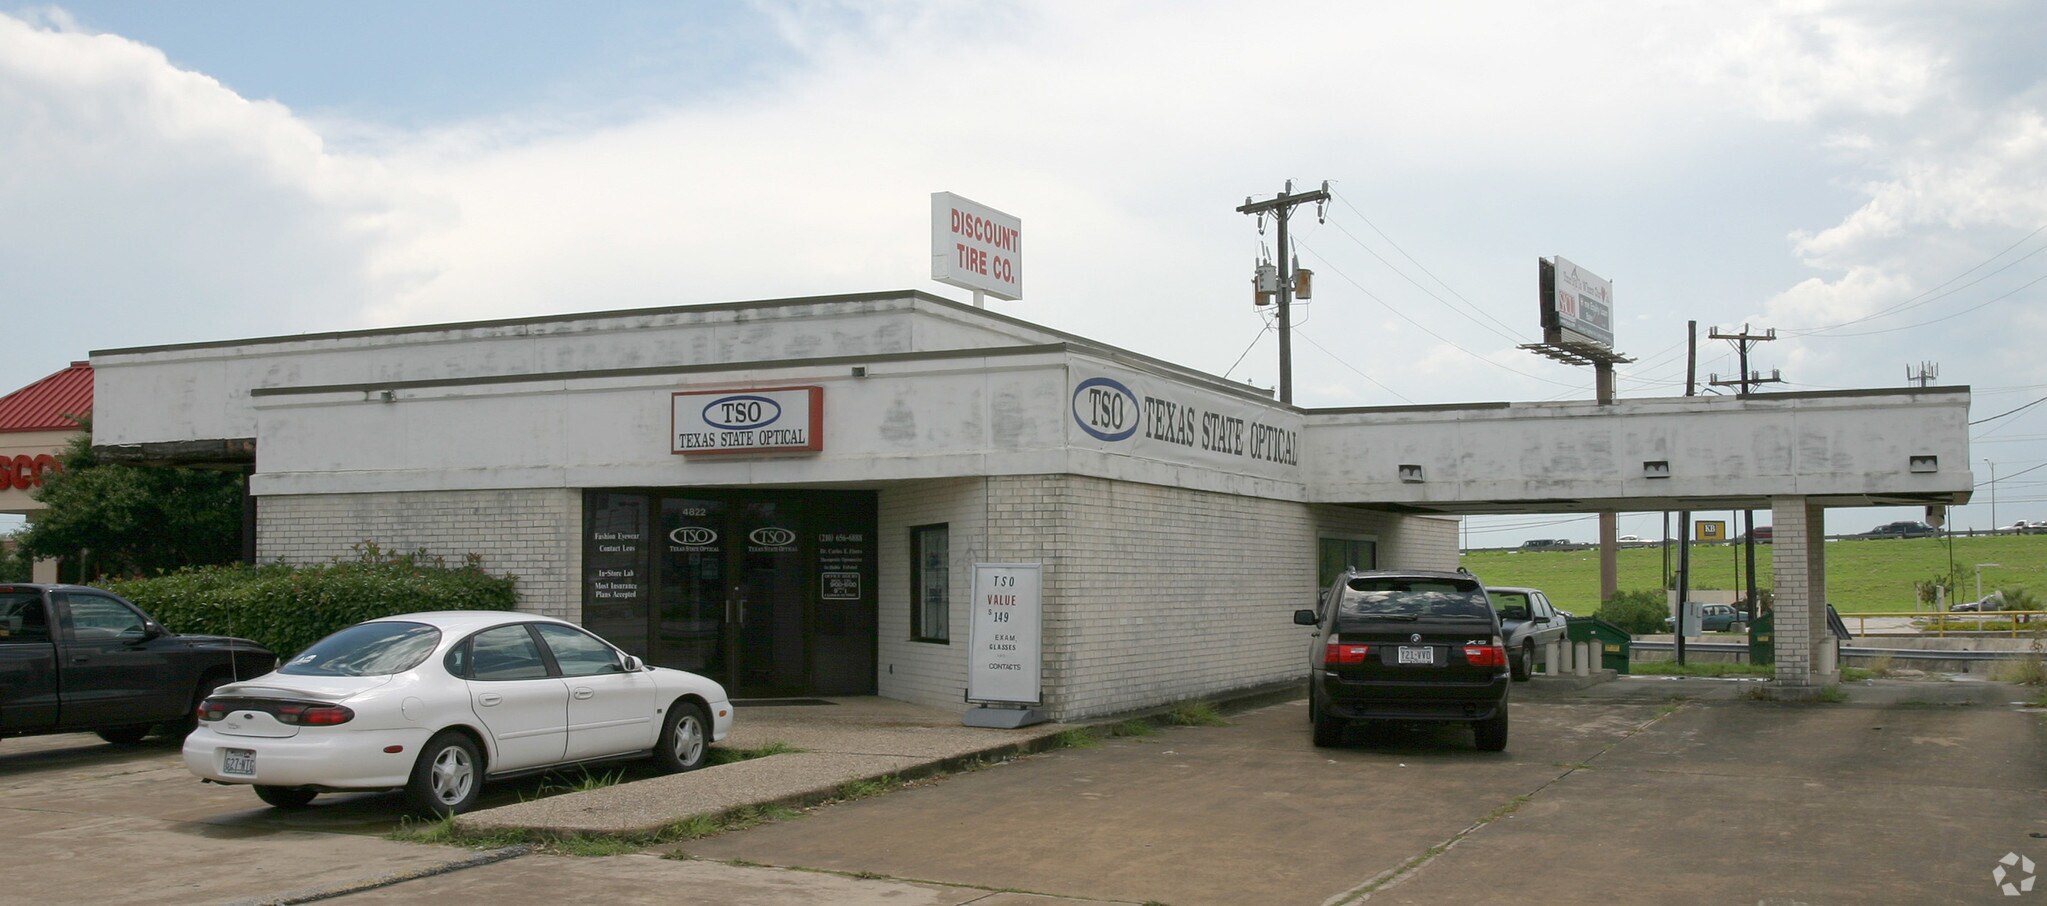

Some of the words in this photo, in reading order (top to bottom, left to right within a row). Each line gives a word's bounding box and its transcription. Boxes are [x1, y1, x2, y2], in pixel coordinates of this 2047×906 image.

[951, 207, 1019, 253] DISCOUNT
[957, 243, 987, 276] TIRE
[993, 255, 1015, 284] CO.
[721, 401, 762, 423] TSO
[1088, 388, 1124, 430] TSO
[1144, 396, 1195, 447] TEXAS
[1201, 411, 1244, 456] STATE
[1249, 422, 1298, 466] OPTICAL
[679, 432, 715, 448] TEXAS
[720, 430, 754, 447] STATE
[759, 428, 805, 446] OPTICAL
[682, 507, 706, 517] 4822
[1705, 524, 1716, 533] KB
[594, 532, 616, 540] Fashion
[617, 532, 640, 541] Eyewear
[680, 529, 708, 543] TSO
[759, 530, 786, 544] TSO
[598, 569, 622, 577] In-Store
[623, 569, 634, 577] Lab
[612, 591, 637, 599] Accepted
[987, 595, 1016, 606] VALUE
[989, 663, 1021, 671] CONTACTS
